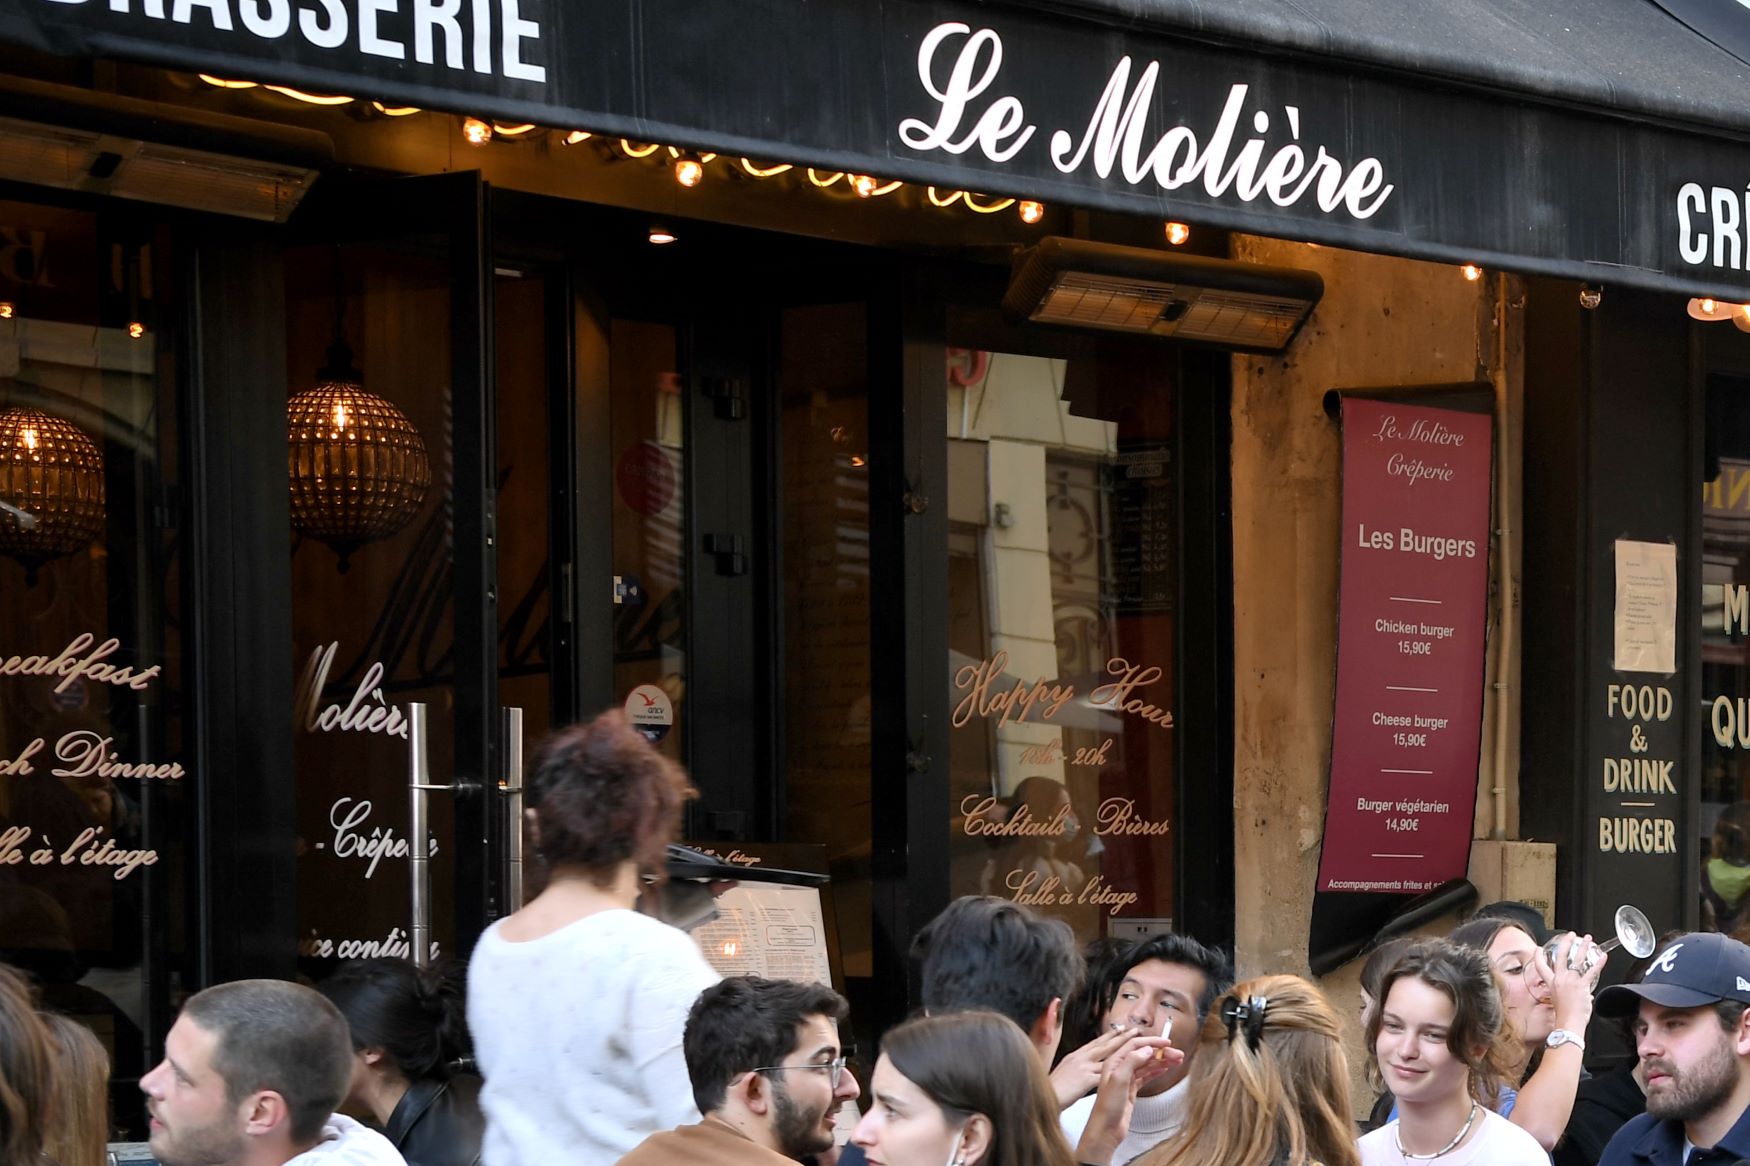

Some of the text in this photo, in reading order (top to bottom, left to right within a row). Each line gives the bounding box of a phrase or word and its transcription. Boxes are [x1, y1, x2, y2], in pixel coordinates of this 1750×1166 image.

[897, 22, 1394, 220] Le Molière
[1372, 415, 1465, 447] Le Molière
[1387, 453, 1454, 485] Crêperie
[1358, 523, 1476, 560] Les Burgers
[1375, 619, 1454, 640] Chicken burger
[1397, 640, 1431, 656] 15,90€
[300, 641, 409, 740] Molièr
[952, 649, 1074, 728] Happy
[1088, 656, 1175, 729] Hour
[1607, 684, 1674, 722] FOOD
[1372, 712, 1448, 731] Cheese burger
[1392, 732, 1426, 748] 15,90€
[1629, 725, 1649, 753] &
[51, 730, 186, 780] Dinner
[1603, 758, 1678, 795] DRINK
[960, 794, 1066, 838] Cocktails
[1092, 796, 1169, 837] Bières
[1357, 797, 1449, 817] Burger végétarien
[1385, 817, 1419, 833] 14,90€
[29, 833, 54, 866] à
[60, 826, 160, 881] l'étage
[329, 797, 439, 880] Crêpe
[1600, 816, 1678, 855] BURGER
[1004, 870, 1138, 919] Salle à l'étage
[1328, 878, 1402, 892] Accompagnements
[1403, 880, 1423, 890] frites
[1424, 881, 1432, 890] et
